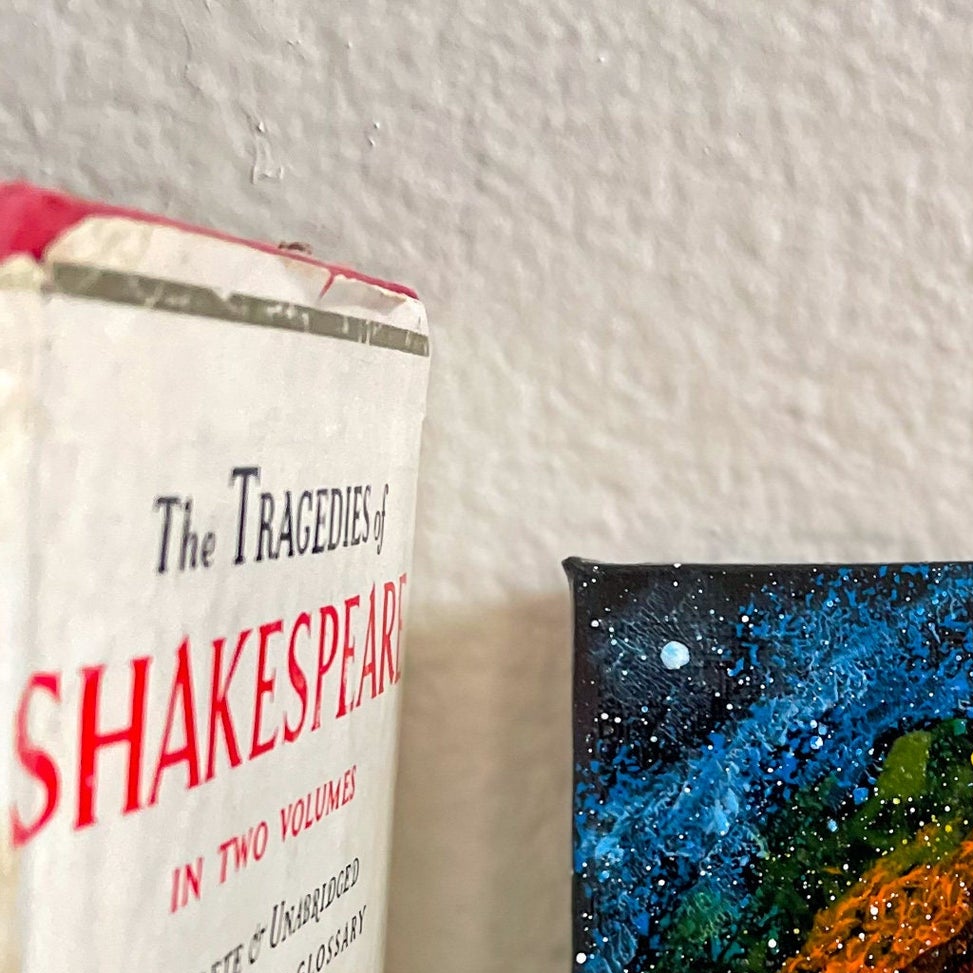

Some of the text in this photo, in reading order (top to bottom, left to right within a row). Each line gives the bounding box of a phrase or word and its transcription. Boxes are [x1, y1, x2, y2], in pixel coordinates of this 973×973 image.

[152, 466, 390, 575] The TRAGEDIES of
[168, 764, 358, 915] IN TWO VOLUMES
[248, 922, 267, 965] &
[269, 857, 360, 949] UNABRIDGED
